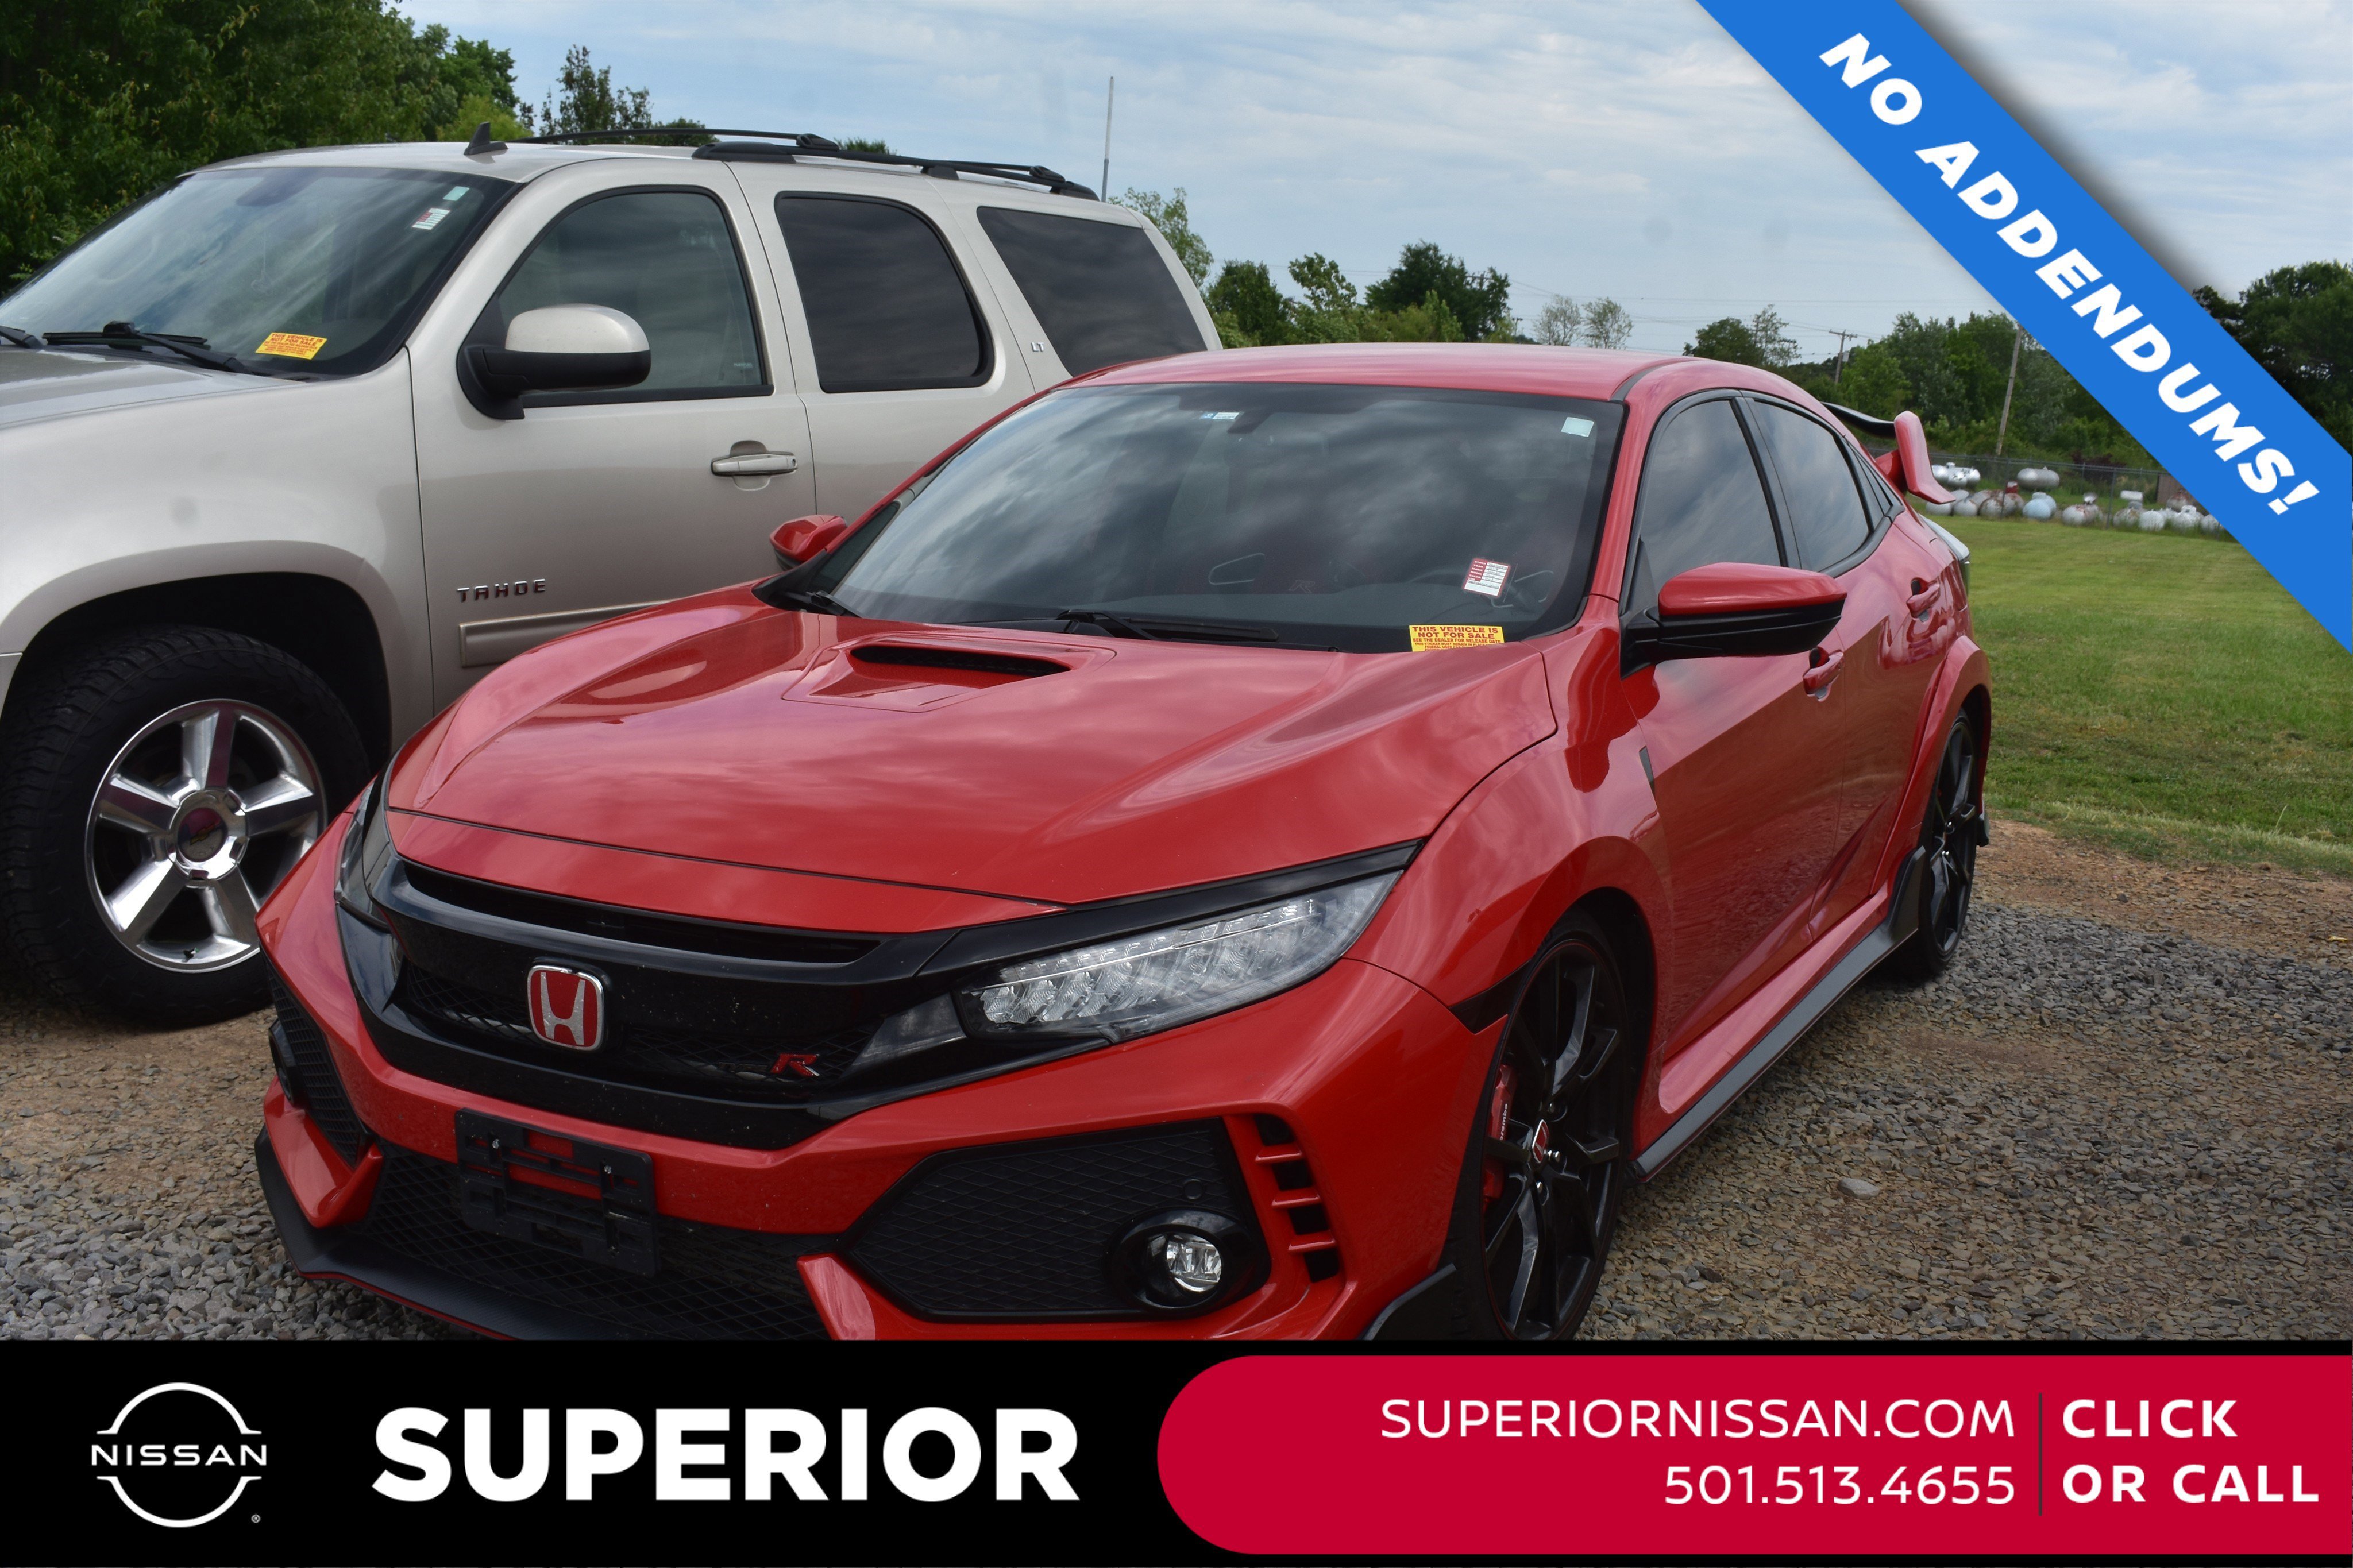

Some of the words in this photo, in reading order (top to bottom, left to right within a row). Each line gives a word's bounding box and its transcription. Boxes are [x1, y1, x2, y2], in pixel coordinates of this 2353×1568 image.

[1031, 342, 1044, 352] LT
[457, 578, 546, 602] TAHOE
[770, 1053, 820, 1077] R
